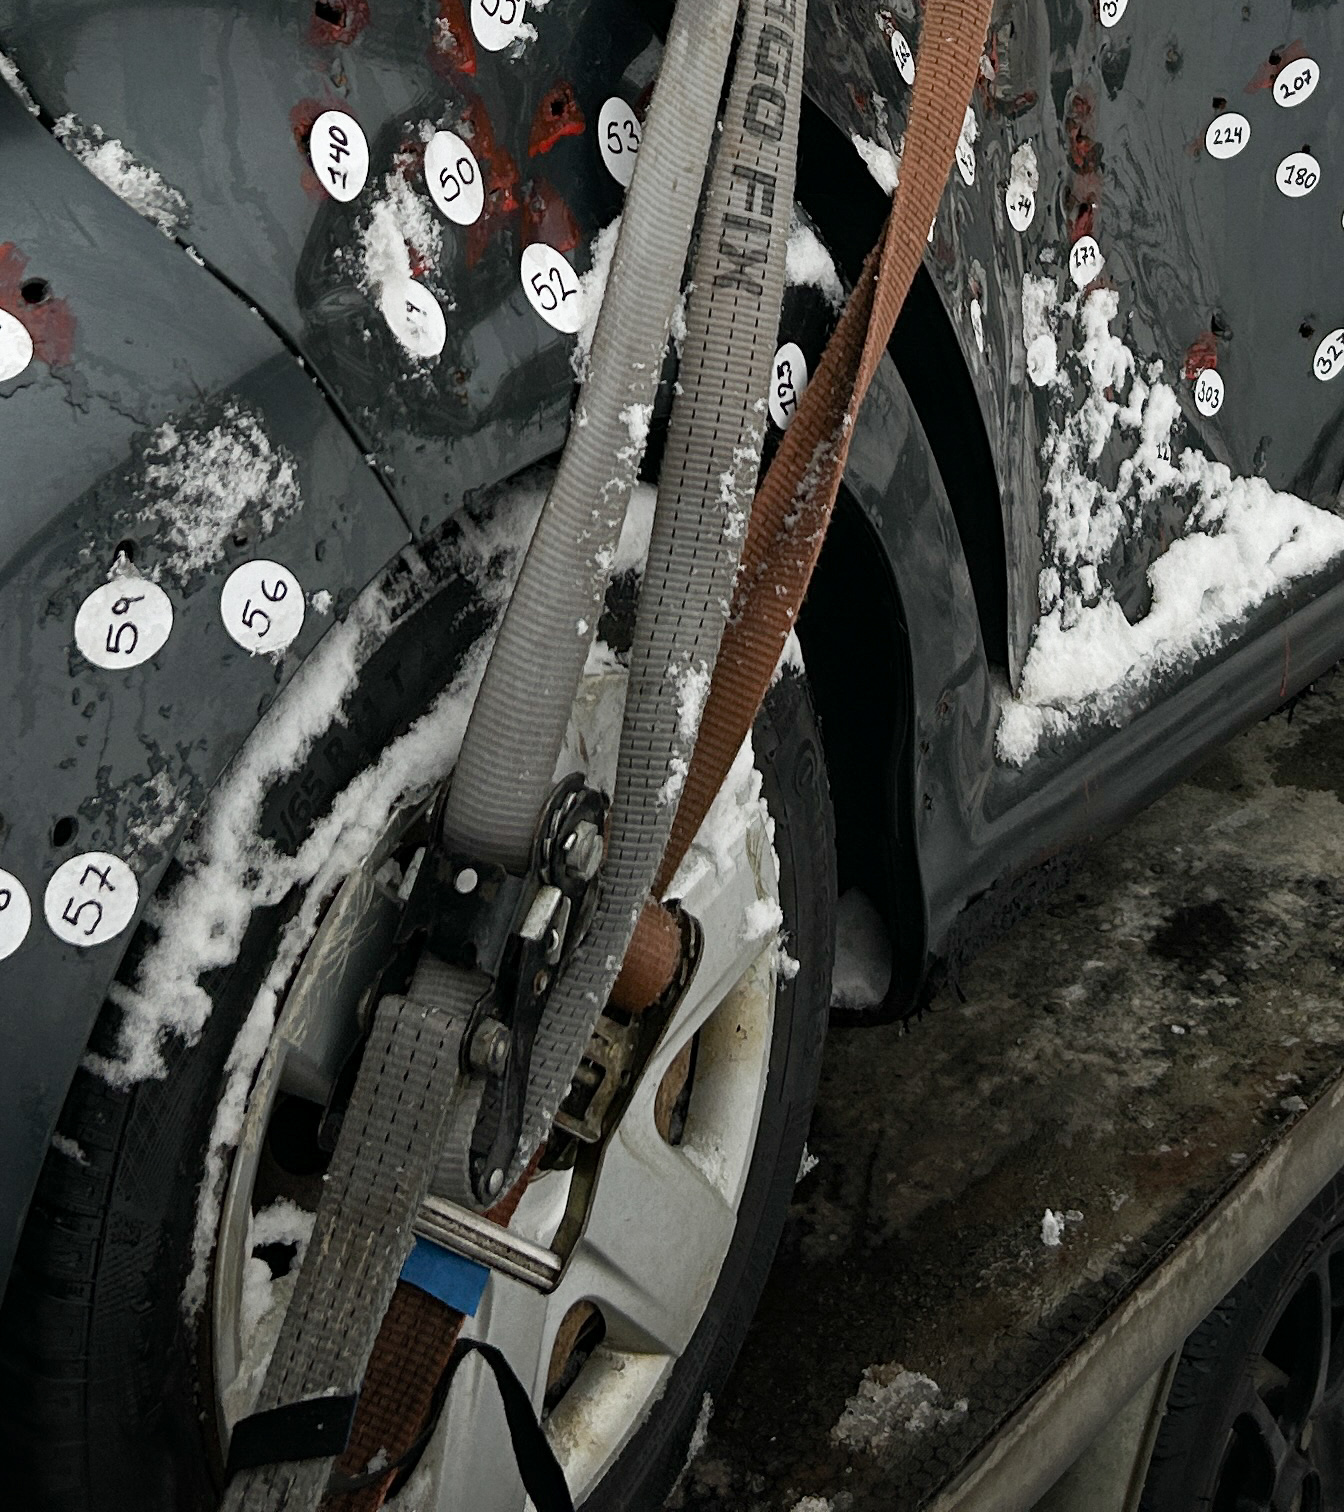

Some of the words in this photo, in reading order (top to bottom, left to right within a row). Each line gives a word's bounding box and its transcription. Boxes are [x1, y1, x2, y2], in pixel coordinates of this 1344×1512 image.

[1280, 68, 1313, 100] 207
[608, 120, 640, 155] 53
[1213, 127, 1242, 145] 224
[440, 157, 474, 202] 50
[1284, 165, 1316, 189] 180
[713, 164, 777, 296] FIX
[531, 267, 577, 310] 52
[1197, 380, 1220, 409] 303
[106, 595, 145, 654] 59
[242, 580, 288, 638] 56
[62, 865, 115, 936] 57
